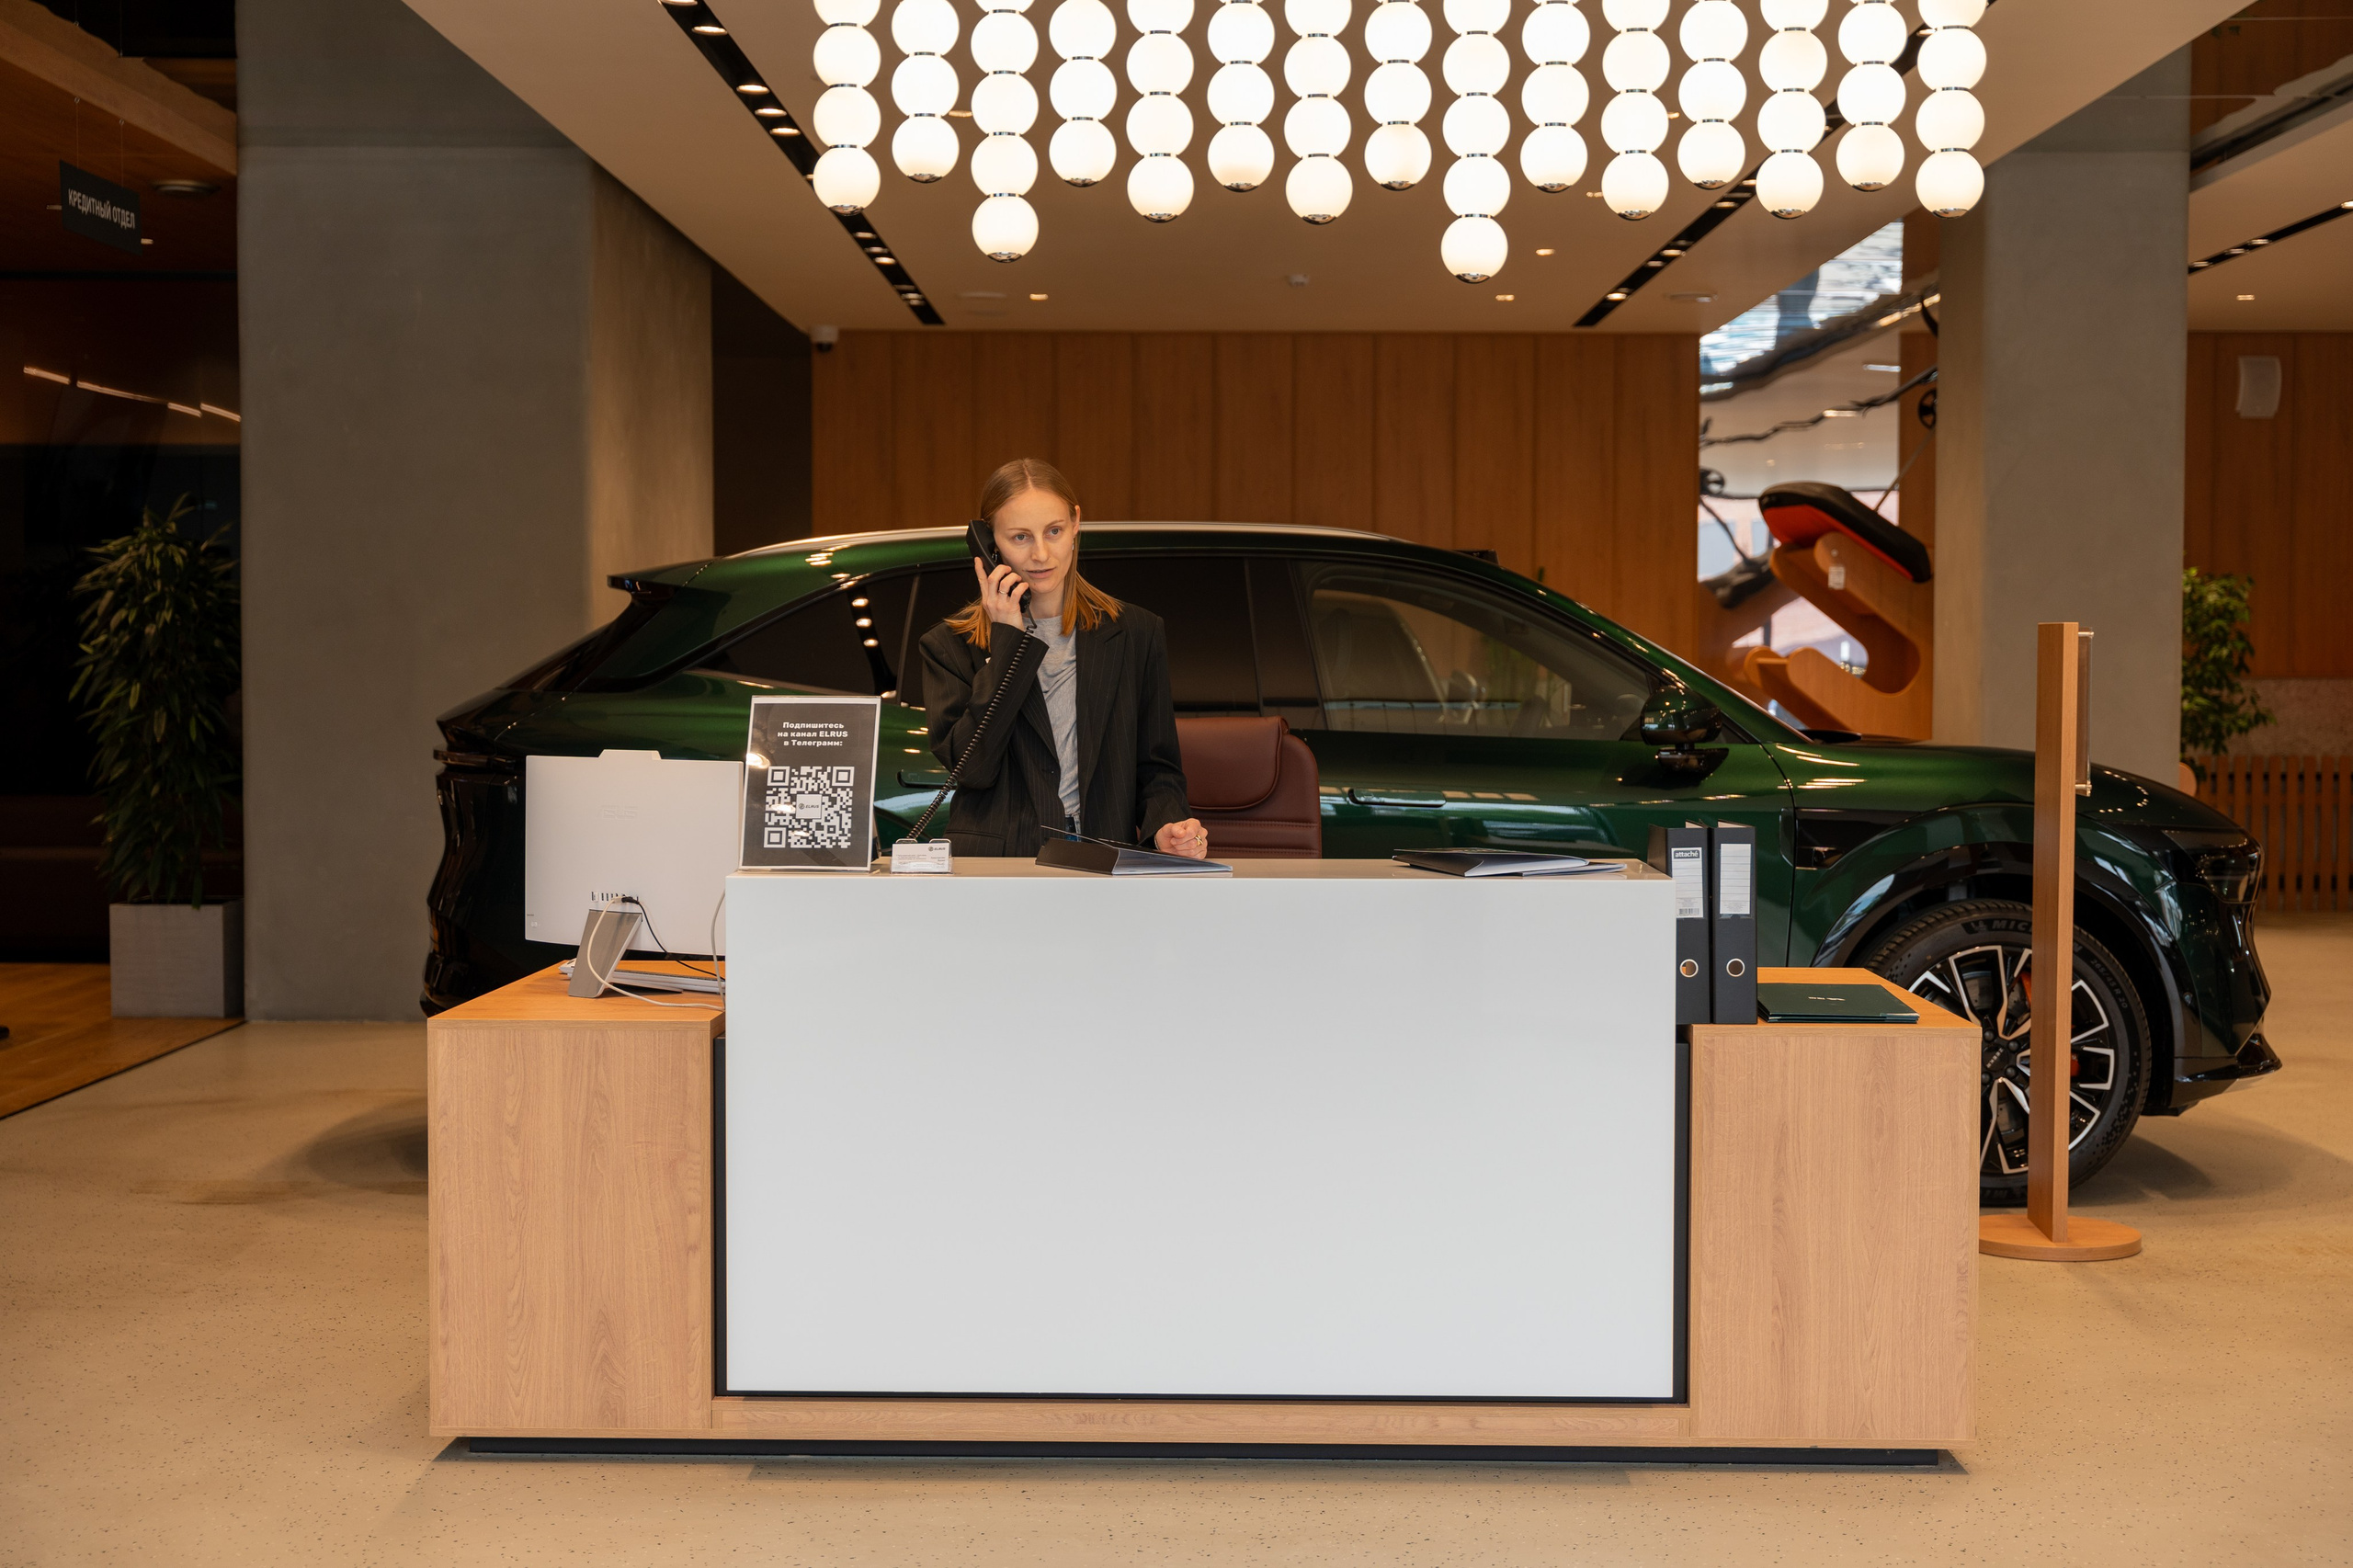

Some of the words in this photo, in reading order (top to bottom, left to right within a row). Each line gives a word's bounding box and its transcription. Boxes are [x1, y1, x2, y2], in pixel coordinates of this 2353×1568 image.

[68, 187, 112, 222] КРЕДИТНЫЙ
[112, 205, 136, 231] ОТДЕЛ
[790, 739, 843, 747] Телеграмм:
